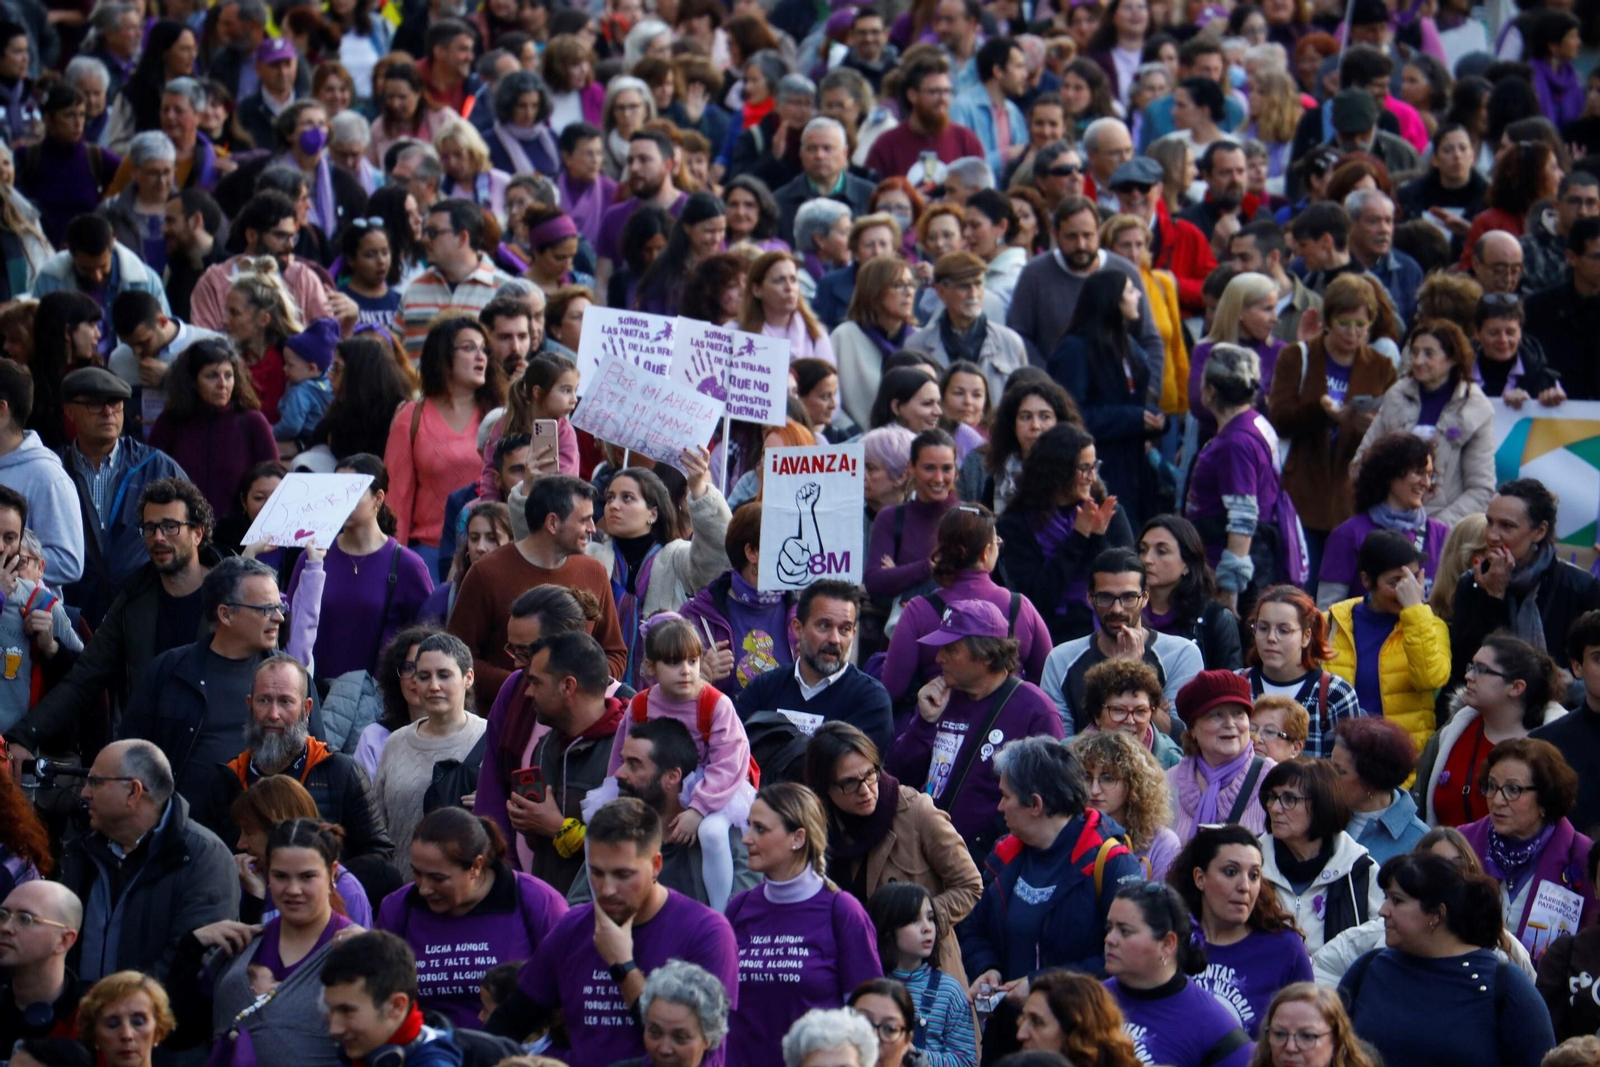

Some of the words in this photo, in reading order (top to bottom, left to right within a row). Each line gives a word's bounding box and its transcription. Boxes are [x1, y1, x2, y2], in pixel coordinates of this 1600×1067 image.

[617, 316, 649, 328] SOMOS
[601, 325, 618, 335] LAS
[620, 327, 650, 340] NIETAS
[704, 330, 732, 343] SOMOS
[628, 342, 638, 352] DE
[640, 344, 655, 355] LAS
[656, 346, 673, 357] BRU
[690, 337, 705, 349] LAS
[706, 341, 734, 355] NIETAS
[643, 360, 667, 376] QUE
[714, 356, 723, 366] DE
[725, 359, 739, 369] LAS
[741, 361, 771, 375] BRUJAS
[729, 374, 751, 390] QUE
[753, 380, 769, 393] NO
[595, 382, 628, 406] POR
[604, 361, 638, 391] POR
[662, 391, 714, 422] ABUELA
[730, 393, 772, 408] PUDISTEIS
[726, 402, 769, 420] QUEMAR
[772, 453, 857, 477] ¡AVANZA!
[808, 551, 851, 575] 8M
[425, 944, 452, 954] LUCHA
[455, 942, 490, 952] AUNQUE
[750, 948, 760, 956] TE
[762, 947, 784, 957] FALTE
[788, 947, 809, 957] NADA
[430, 959, 440, 968] TE
[444, 957, 470, 967] FALTE
[474, 956, 498, 966] NADA
[739, 960, 764, 969] ORQUE
[766, 960, 804, 969] ALGUNAS
[738, 973, 747, 982] ES
[750, 973, 775, 982] FALTA
[778, 973, 801, 983] TODO
[418, 987, 433, 997] LES
[437, 986, 464, 996] FALTA
[468, 985, 480, 994] TO
[596, 986, 605, 995] TE
[1213, 979, 1255, 1022] HISTORIA
[584, 1016, 598, 1026] LES
